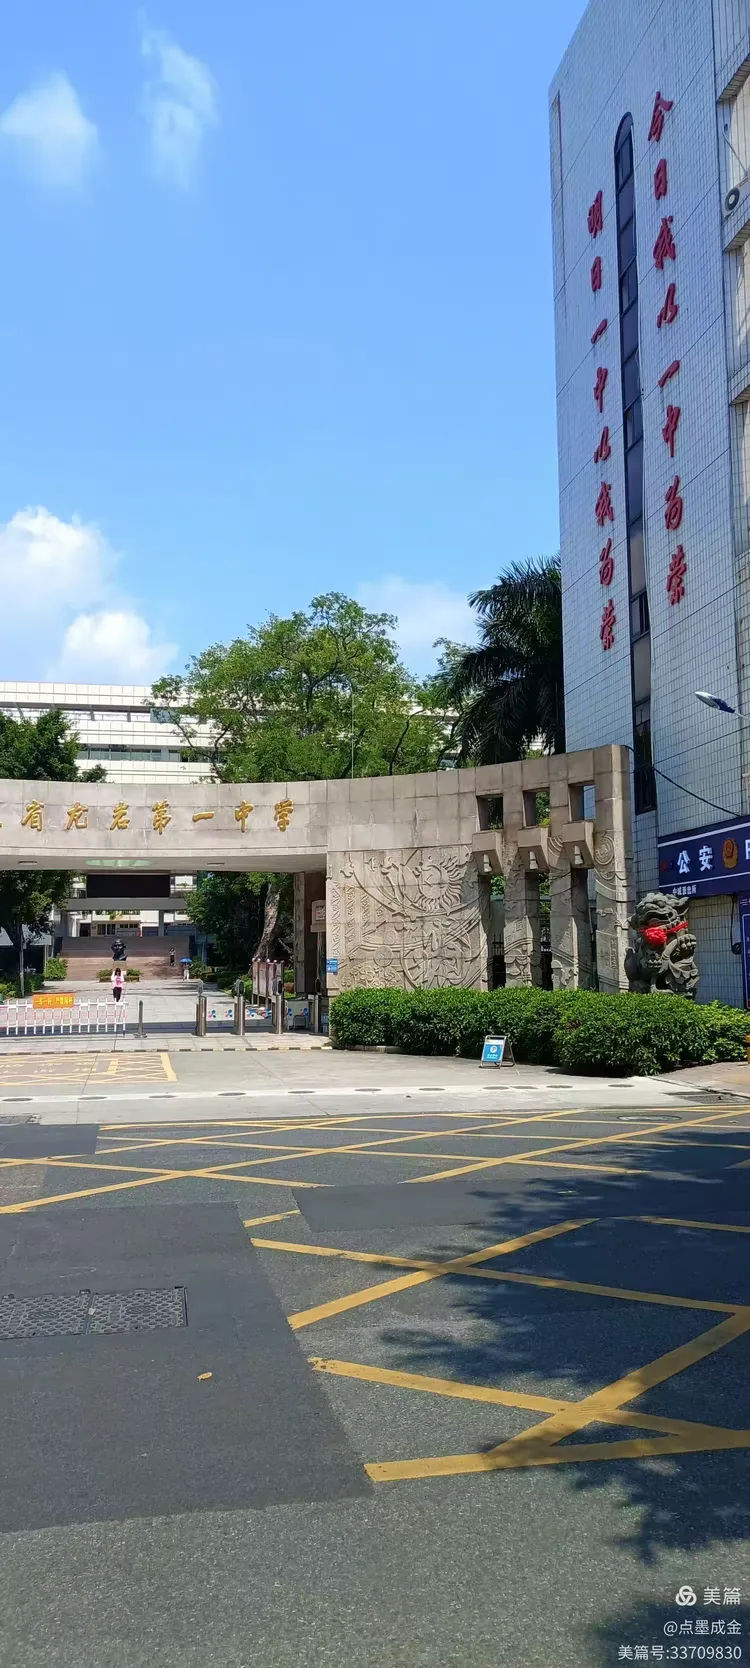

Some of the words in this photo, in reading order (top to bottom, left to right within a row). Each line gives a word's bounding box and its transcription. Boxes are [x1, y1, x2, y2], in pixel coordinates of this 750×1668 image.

[587, 189, 616, 651] 明日一中以我为荣
[648, 90, 687, 606] 今日我以一中为荣
[0, 798, 294, 835] 省龙岩第一中学
[677, 845, 713, 874] 公安
